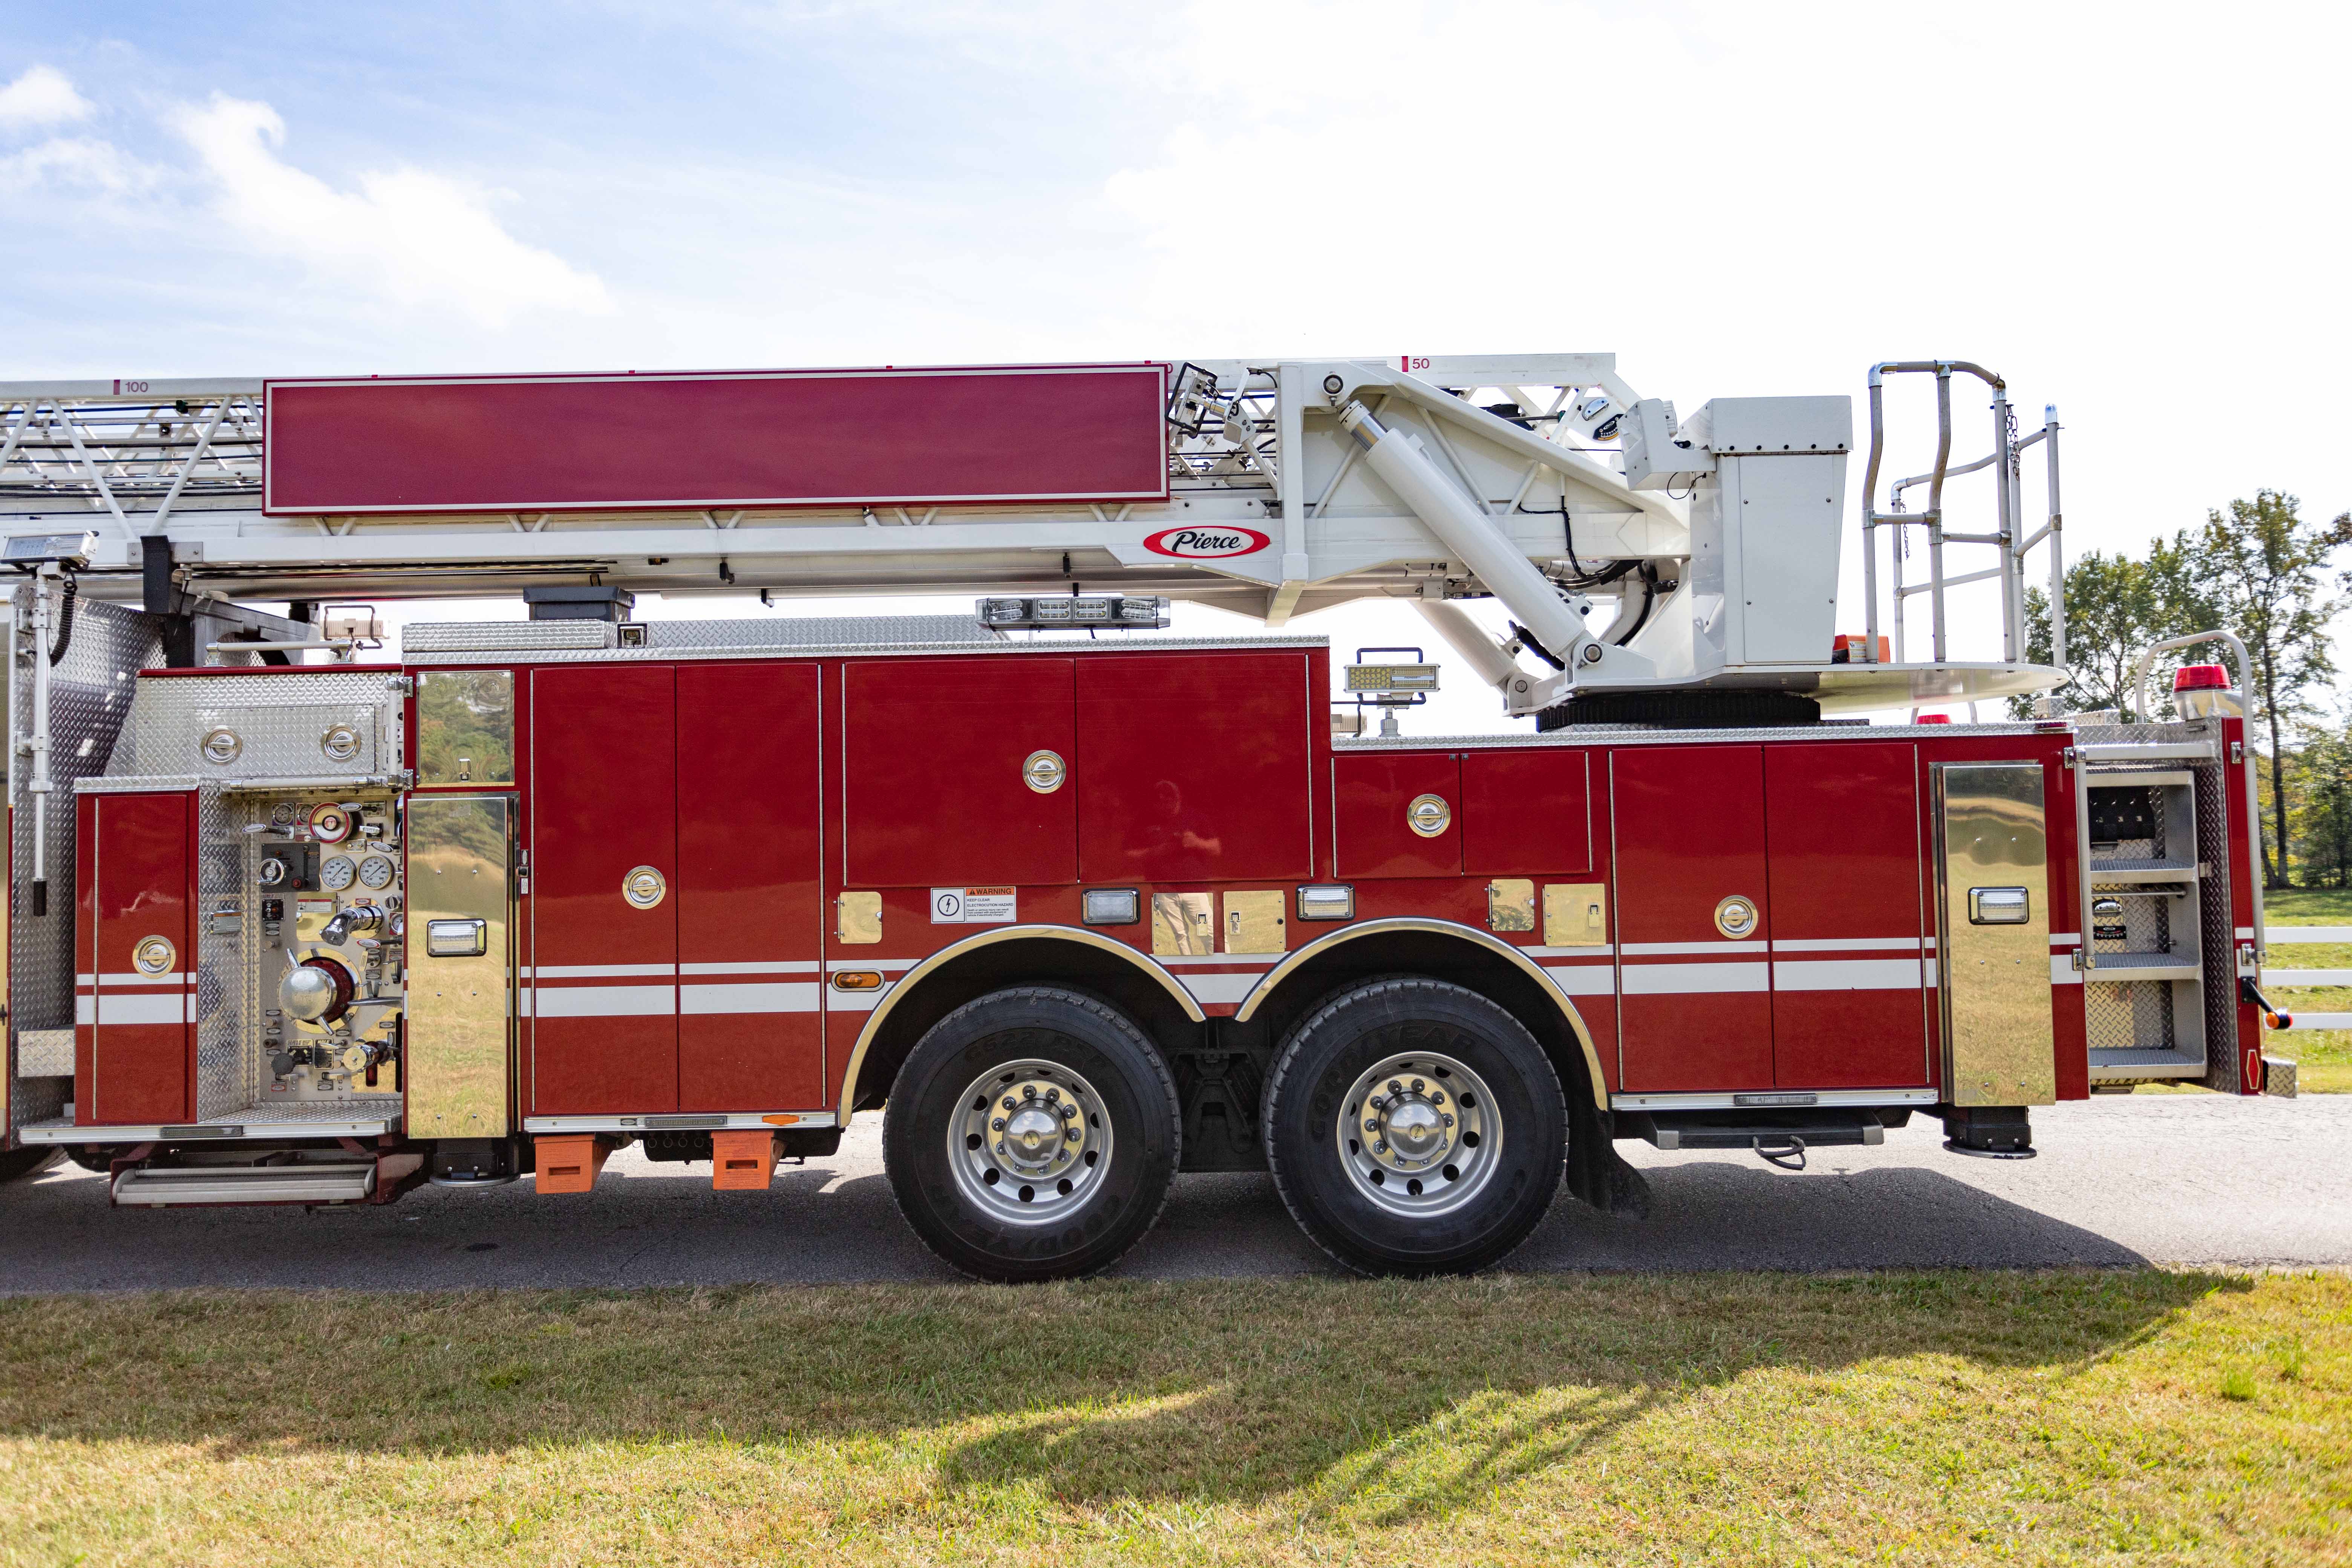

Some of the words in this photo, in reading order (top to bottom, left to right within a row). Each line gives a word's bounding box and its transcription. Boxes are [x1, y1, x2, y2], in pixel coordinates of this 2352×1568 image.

[1412, 358, 1430, 369] 50
[126, 381, 148, 392] 100
[1171, 531, 1240, 552] Pierce
[1311, 1026, 1476, 1142] GOODYEAR
